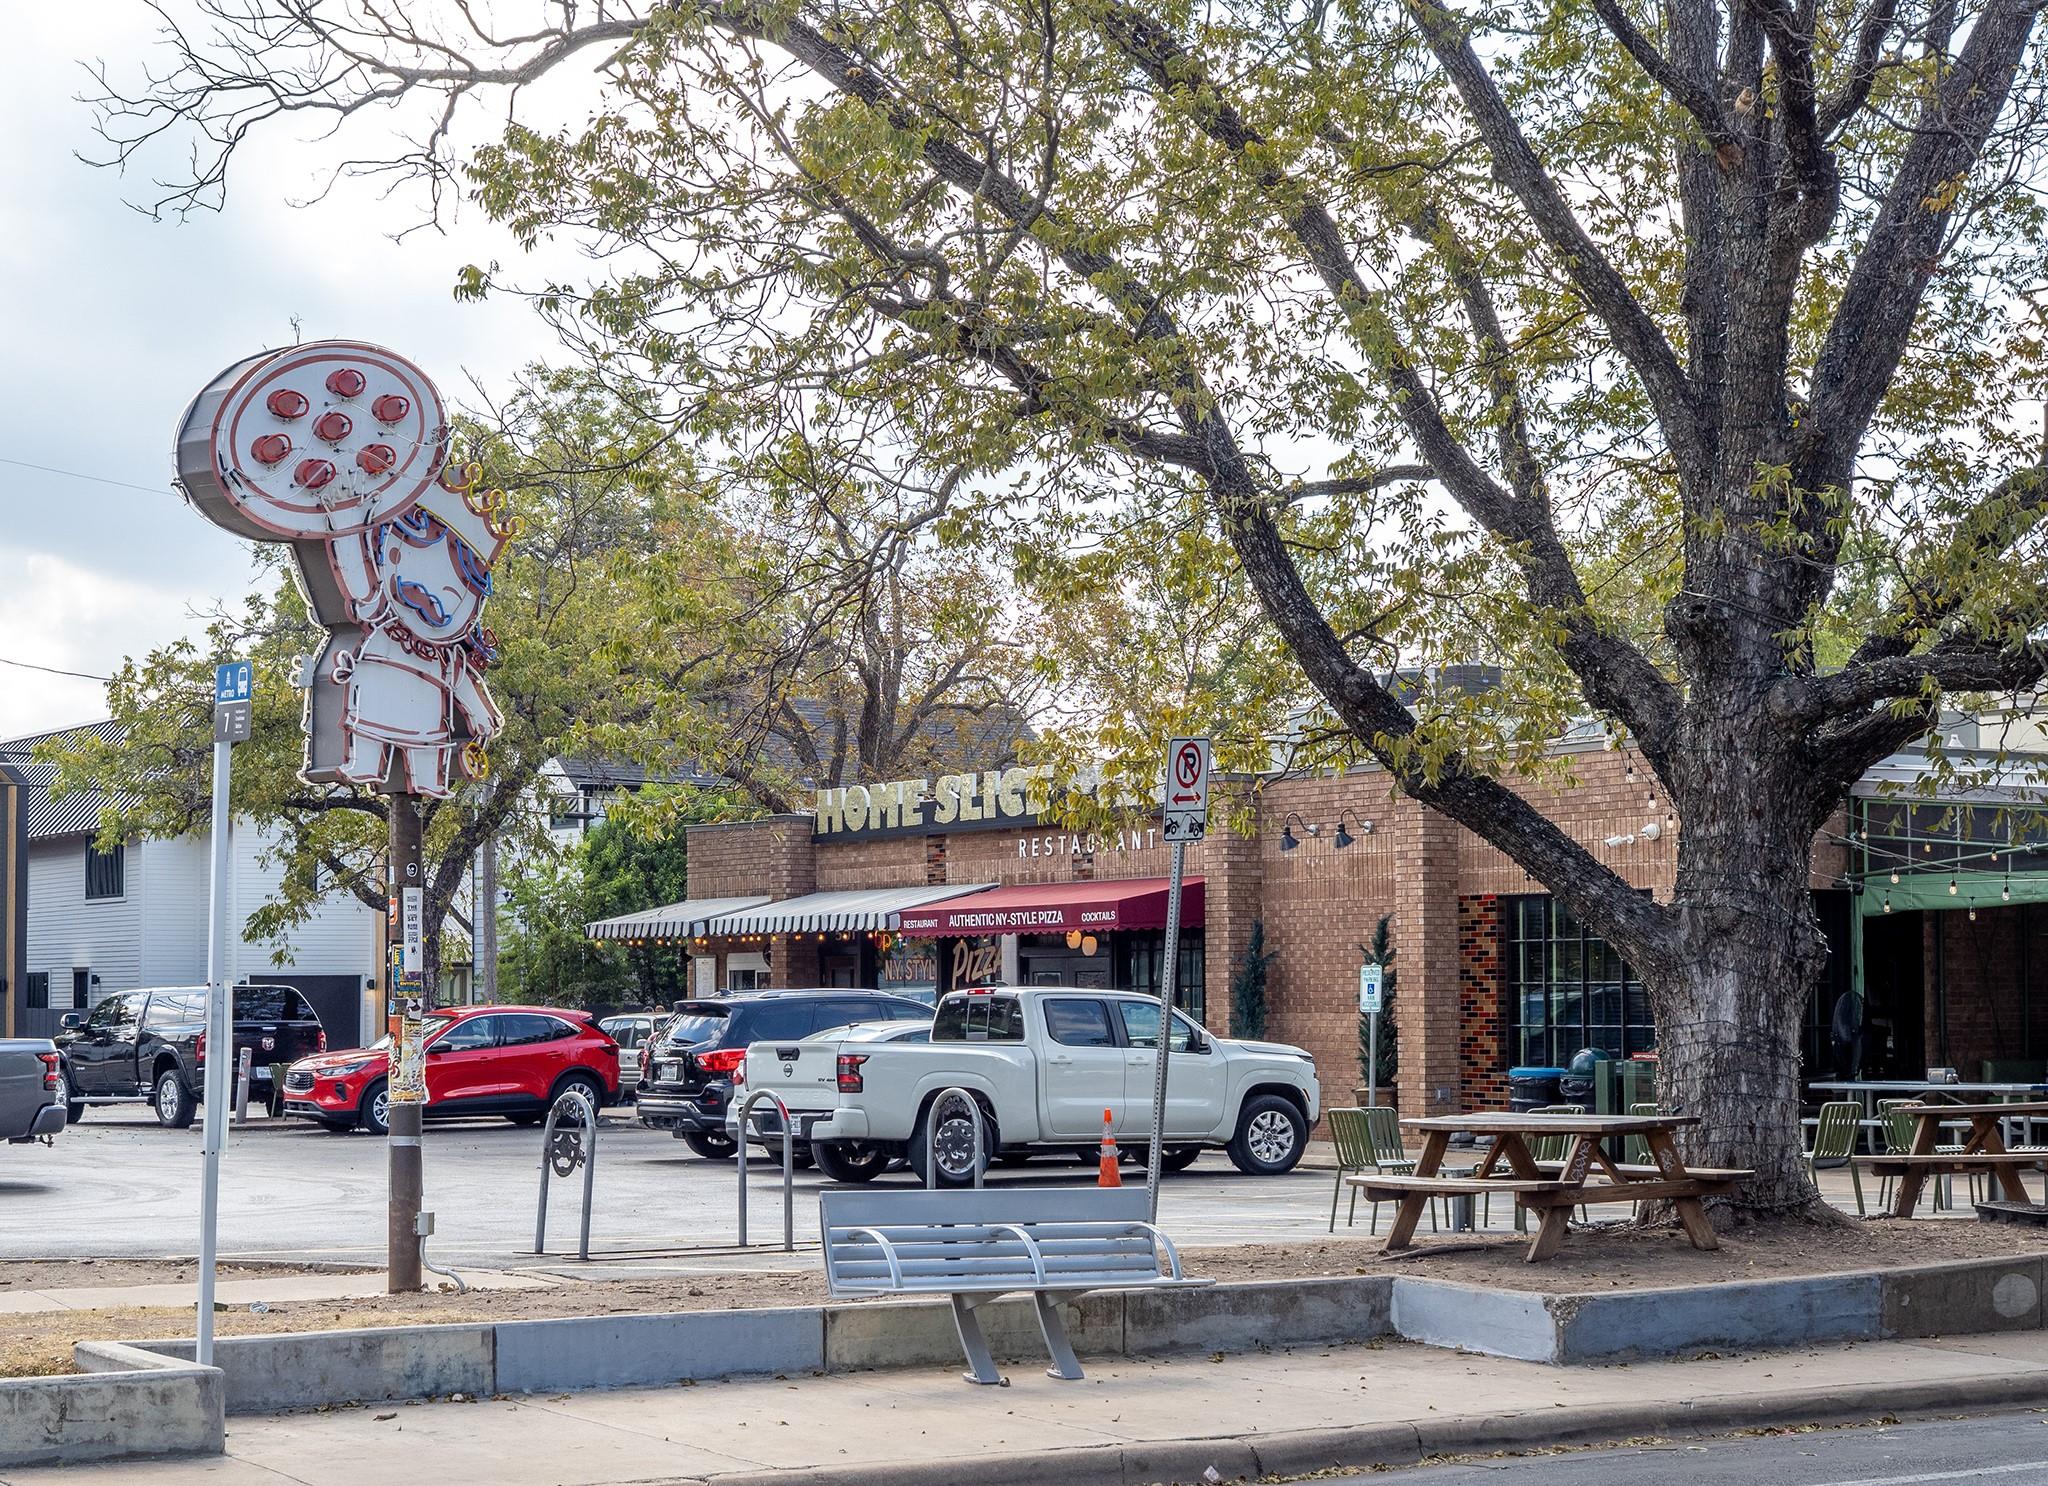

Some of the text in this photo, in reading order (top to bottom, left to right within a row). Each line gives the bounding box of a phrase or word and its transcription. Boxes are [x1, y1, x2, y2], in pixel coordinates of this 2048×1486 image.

[221, 689, 235, 698] METRO
[817, 779, 928, 834] HOME
[949, 910, 1064, 927] AUTHENTIC NY-STYLE PIZZA
[1081, 910, 1116, 922] COCKTAILS
[903, 919, 939, 928] RESTAURANT
[884, 959, 903, 981] N.Y.
